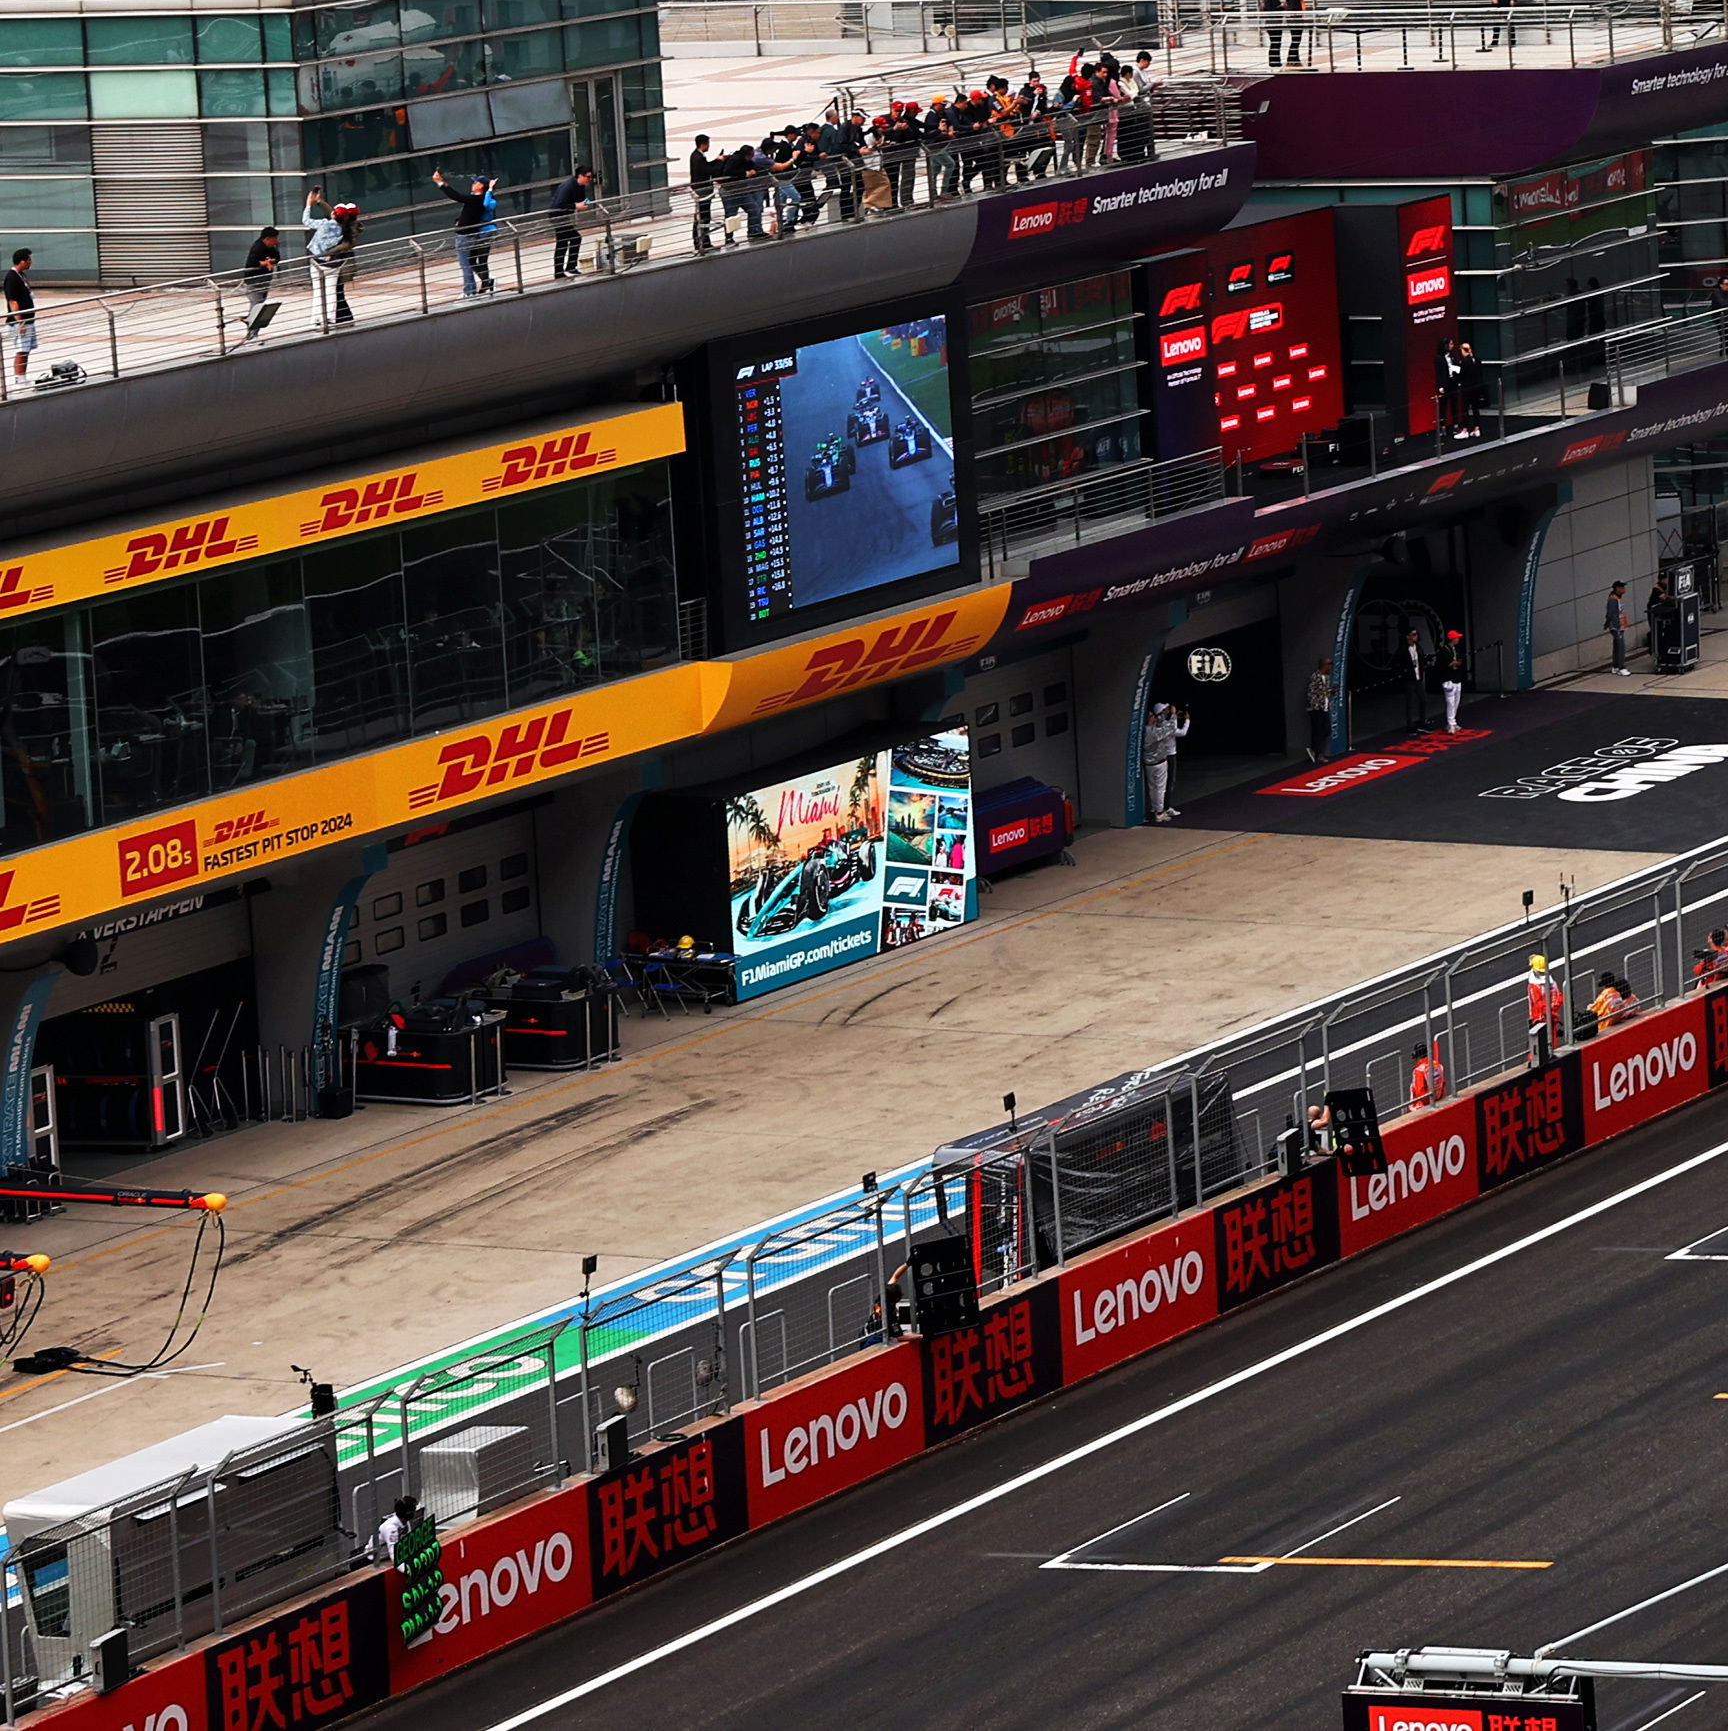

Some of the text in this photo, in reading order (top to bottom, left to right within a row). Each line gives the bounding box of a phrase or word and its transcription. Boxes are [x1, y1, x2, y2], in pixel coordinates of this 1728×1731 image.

[1631, 76, 1666, 95] Smarter
[1667, 65, 1714, 88] technology
[1713, 62, 1726, 76] for
[1092, 169, 1229, 215] Smarter technology for all
[1012, 211, 1053, 232] Lenovo
[1406, 225, 1446, 257] F1
[1159, 282, 1203, 317] F1
[1410, 276, 1445, 297] Lenovo
[761, 361, 774, 373] LAP
[1163, 336, 1202, 359] Lenovo
[1626, 421, 1663, 442] Smarter
[1663, 405, 1713, 431] technology
[1712, 400, 1728, 418] for
[499, 431, 600, 487] DHL
[1562, 442, 1598, 462] Lenovo
[319, 473, 425, 533] DHL
[125, 516, 240, 579] DHL
[1103, 547, 1245, 602] Smarter technology for all
[1248, 538, 1288, 558] Lenovo
[1022, 603, 1065, 625] Lenovo
[789, 611, 958, 704] DHL
[1191, 655, 1229, 674] FIA
[436, 709, 587, 802] DHL
[1282, 758, 1397, 793] Lenovo
[1478, 756, 1631, 799] RACE
[213, 810, 270, 843] DHL
[776, 784, 841, 838] Miami
[992, 827, 1025, 847] Lenovo
[125, 838, 192, 883] 2.08s
[203, 813, 353, 872] FASTEST PIT STOP 2024
[602, 820, 624, 881] MIAMI
[886, 875, 926, 899] F1
[94, 895, 205, 942] VERSTAPPEN
[321, 905, 344, 970] MIAMI
[741, 928, 872, 987] F1MiamiGP.com/tickets
[9, 1004, 32, 1073] MIAMI
[1594, 1032, 1697, 1112] Lenovo
[1484, 1069, 1565, 1176] 联想
[1350, 1134, 1466, 1222] Lenovo
[1224, 1177, 1316, 1294] 联想
[1074, 1250, 1204, 1346] Lenovo
[929, 1300, 1033, 1428] 联想
[760, 1382, 909, 1489] Lenovo
[599, 1438, 715, 1570] 联想
[396, 1518, 435, 1561] GEORGE
[408, 1532, 573, 1650] enovo
[217, 1600, 354, 1731] 联想
